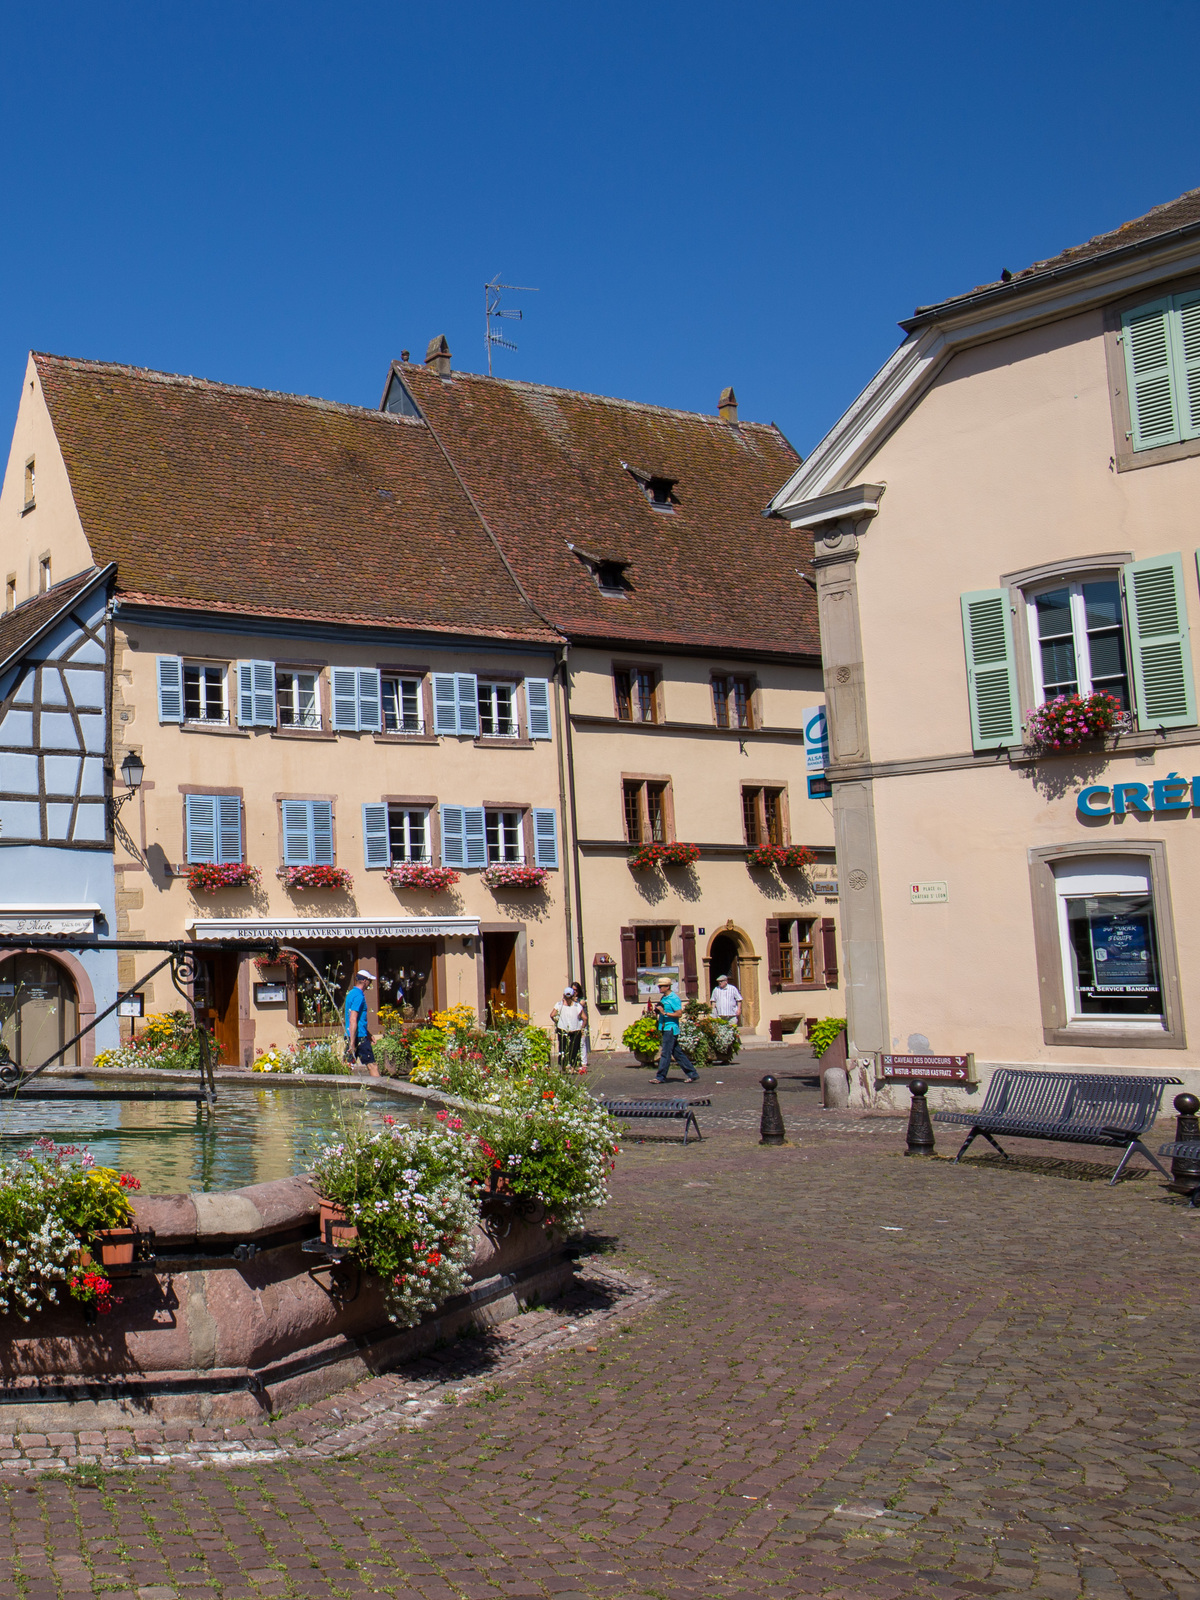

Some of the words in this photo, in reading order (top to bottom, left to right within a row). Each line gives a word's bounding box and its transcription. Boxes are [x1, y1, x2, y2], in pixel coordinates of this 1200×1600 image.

[1077, 771, 1200, 816] CRÉ
[238, 929, 288, 937] RESTAURANT
[894, 1056, 913, 1064] CAVEAU
[924, 1057, 951, 1065] DOUCEURS
